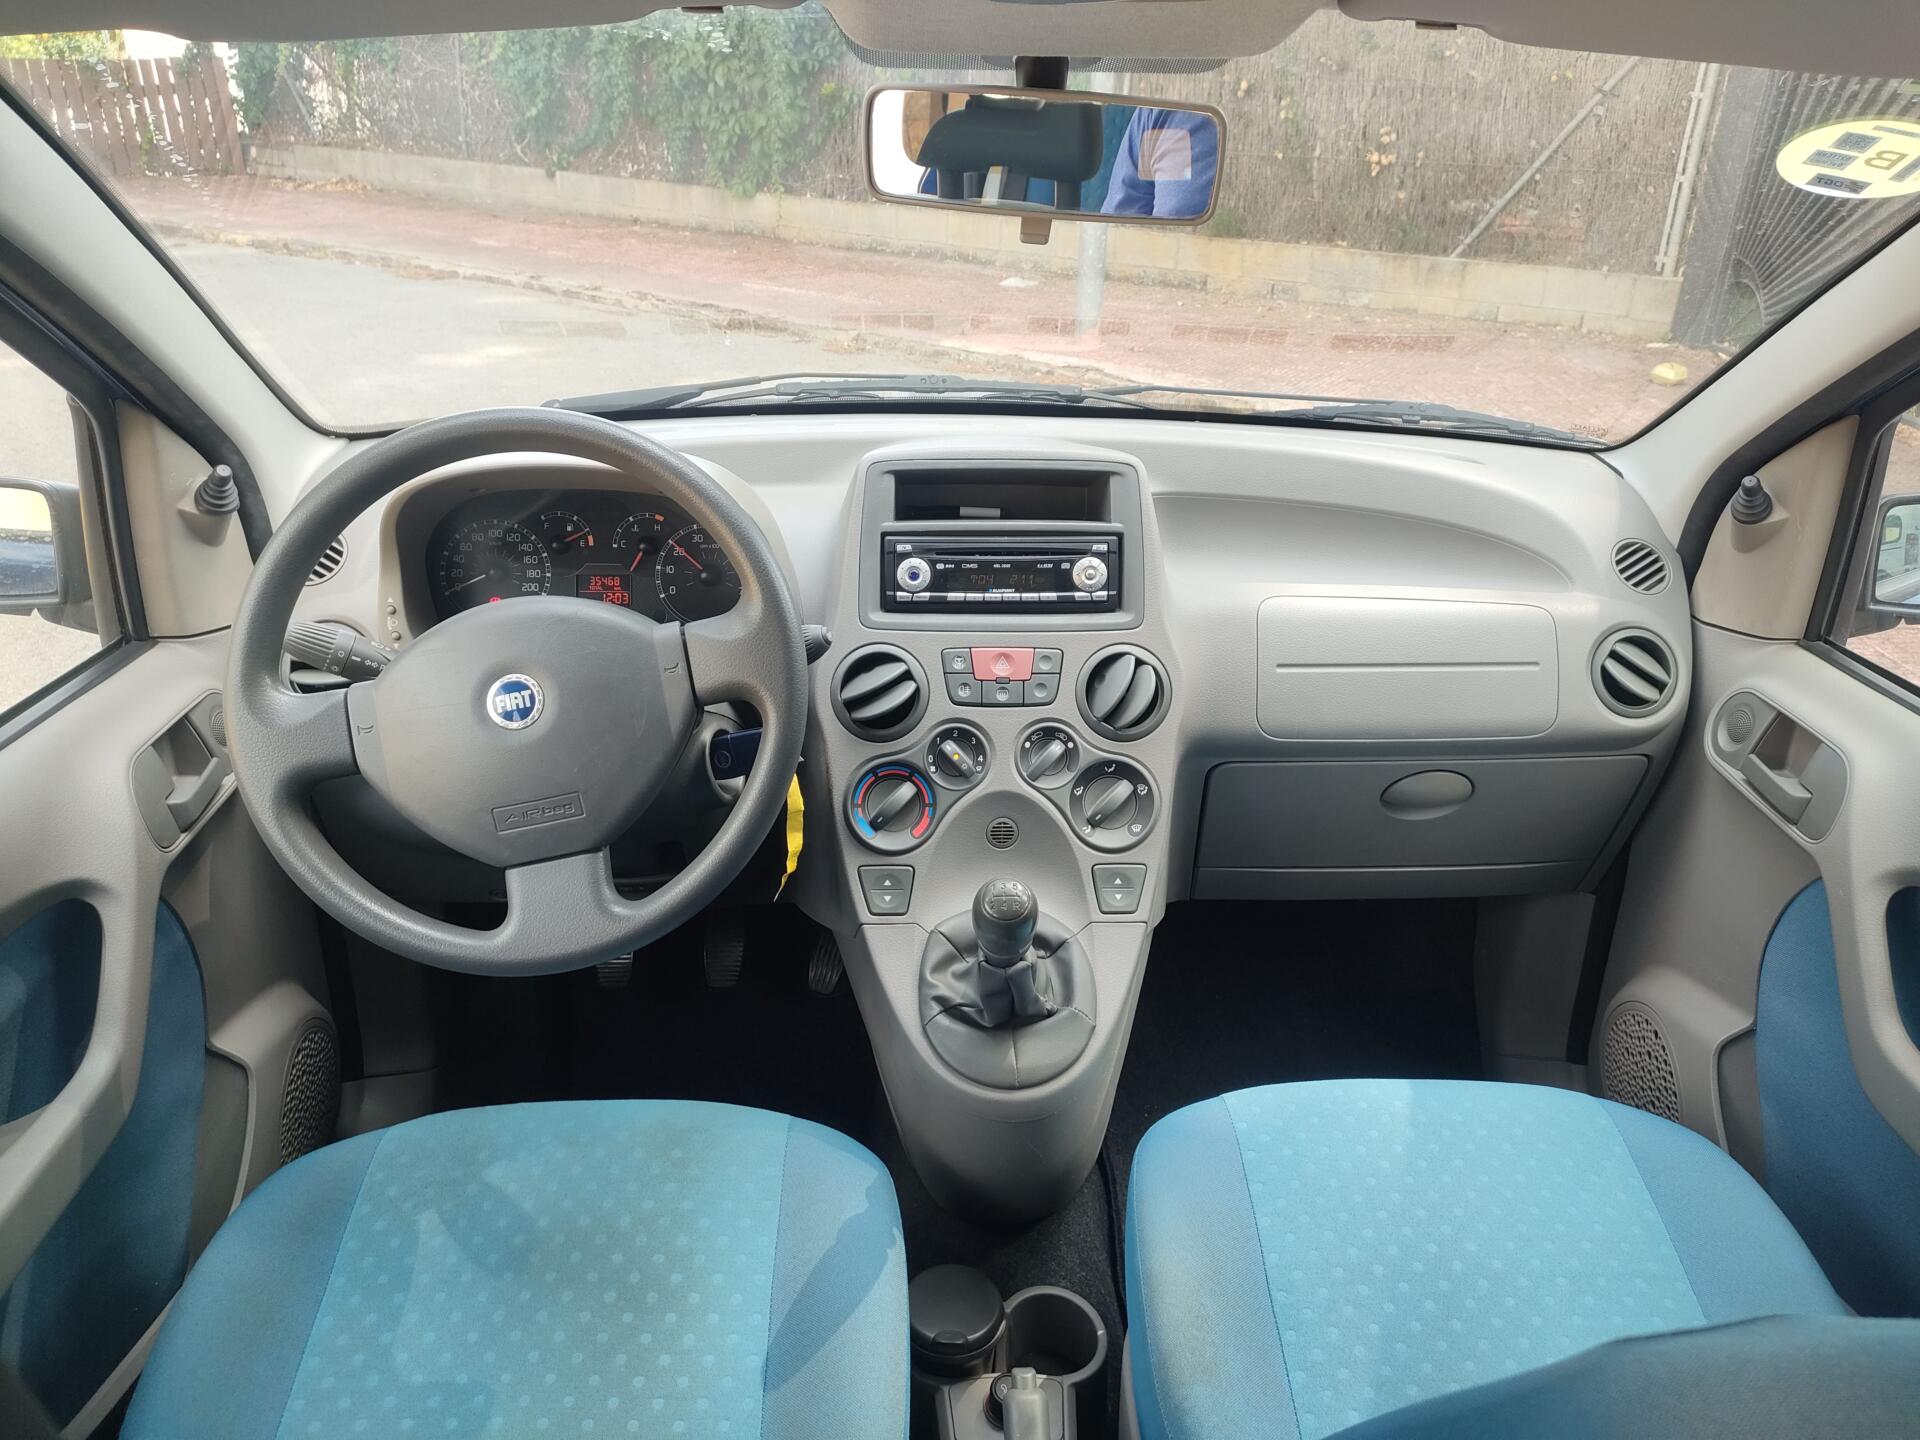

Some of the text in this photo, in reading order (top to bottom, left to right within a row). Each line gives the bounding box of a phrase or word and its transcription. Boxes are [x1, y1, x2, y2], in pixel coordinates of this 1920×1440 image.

[506, 533, 520, 541] 120
[452, 555, 464, 563] 40
[526, 570, 540, 578] 180
[590, 576, 620, 586] 35468
[603, 593, 628, 604] 12:03
[494, 690, 532, 714] FIAT
[990, 901, 1021, 910] 2 4 R
